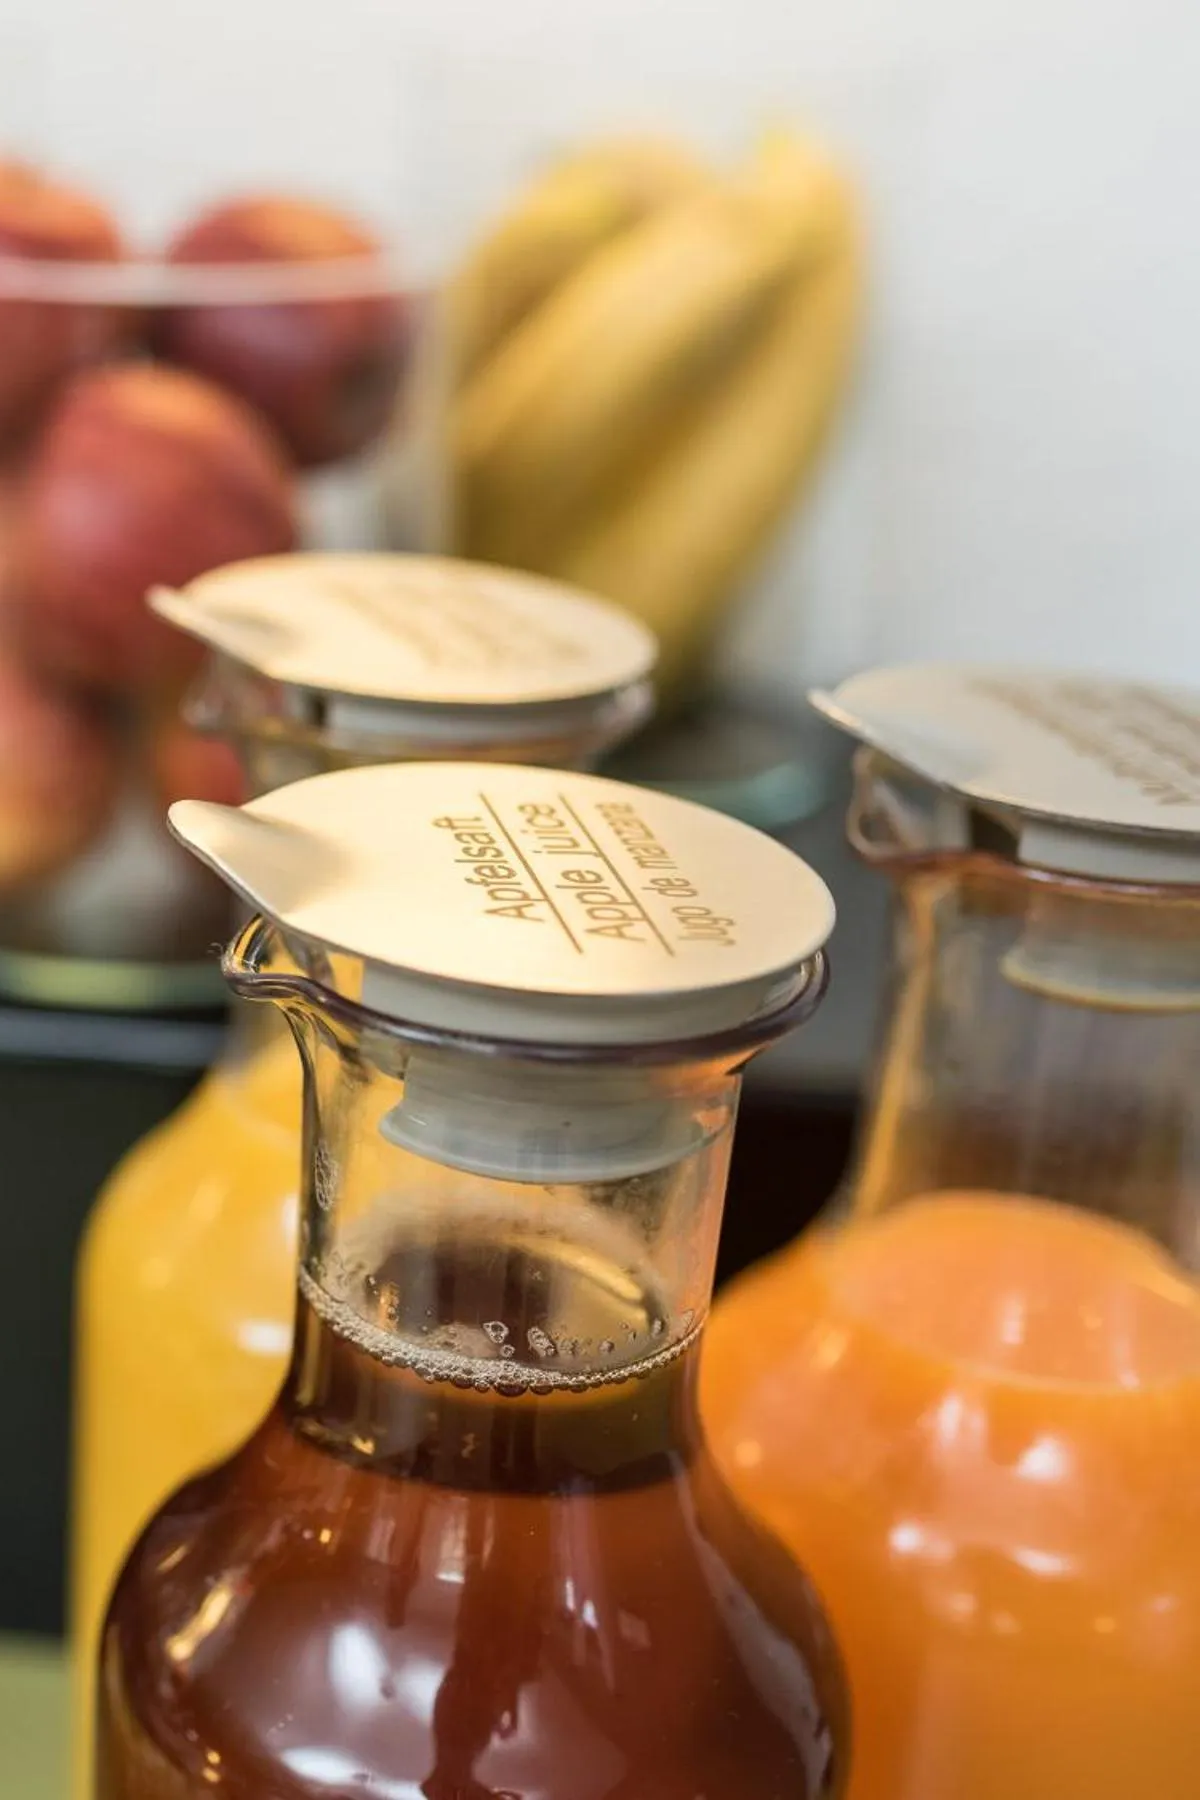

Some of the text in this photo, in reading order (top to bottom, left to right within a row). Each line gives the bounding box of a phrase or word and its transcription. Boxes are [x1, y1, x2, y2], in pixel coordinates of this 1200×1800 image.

[432, 815, 548, 922] Apfelsaft
[517, 803, 647, 941] Apple juice
[641, 878, 698, 898] de
[672, 906, 736, 946] Jugo
